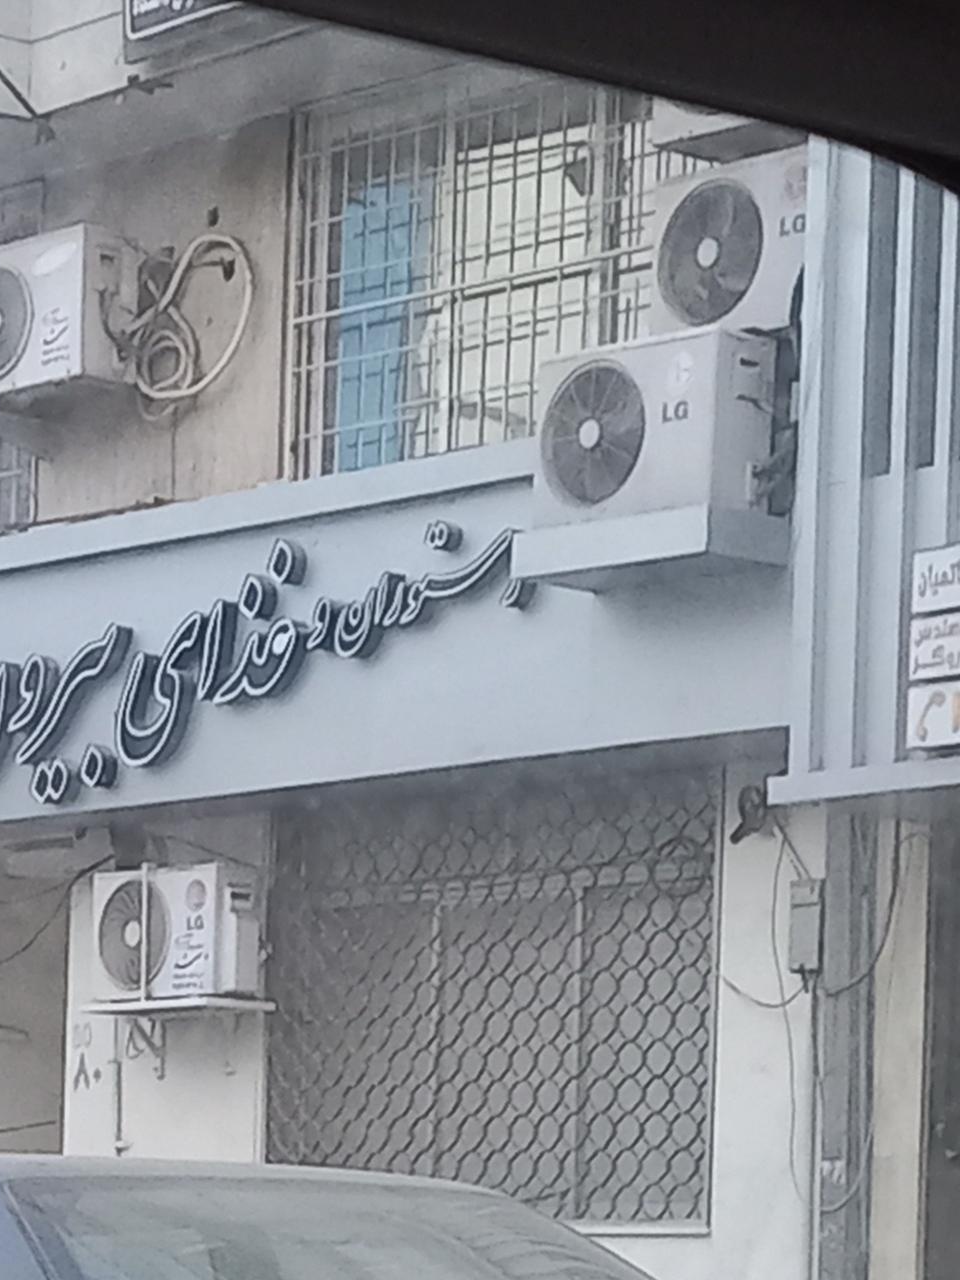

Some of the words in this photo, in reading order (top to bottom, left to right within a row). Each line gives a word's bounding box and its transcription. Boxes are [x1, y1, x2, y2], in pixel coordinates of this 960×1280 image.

[661, 401, 689, 424] LG
[115, 538, 306, 770] غذای
[186, 913, 205, 932] LG
